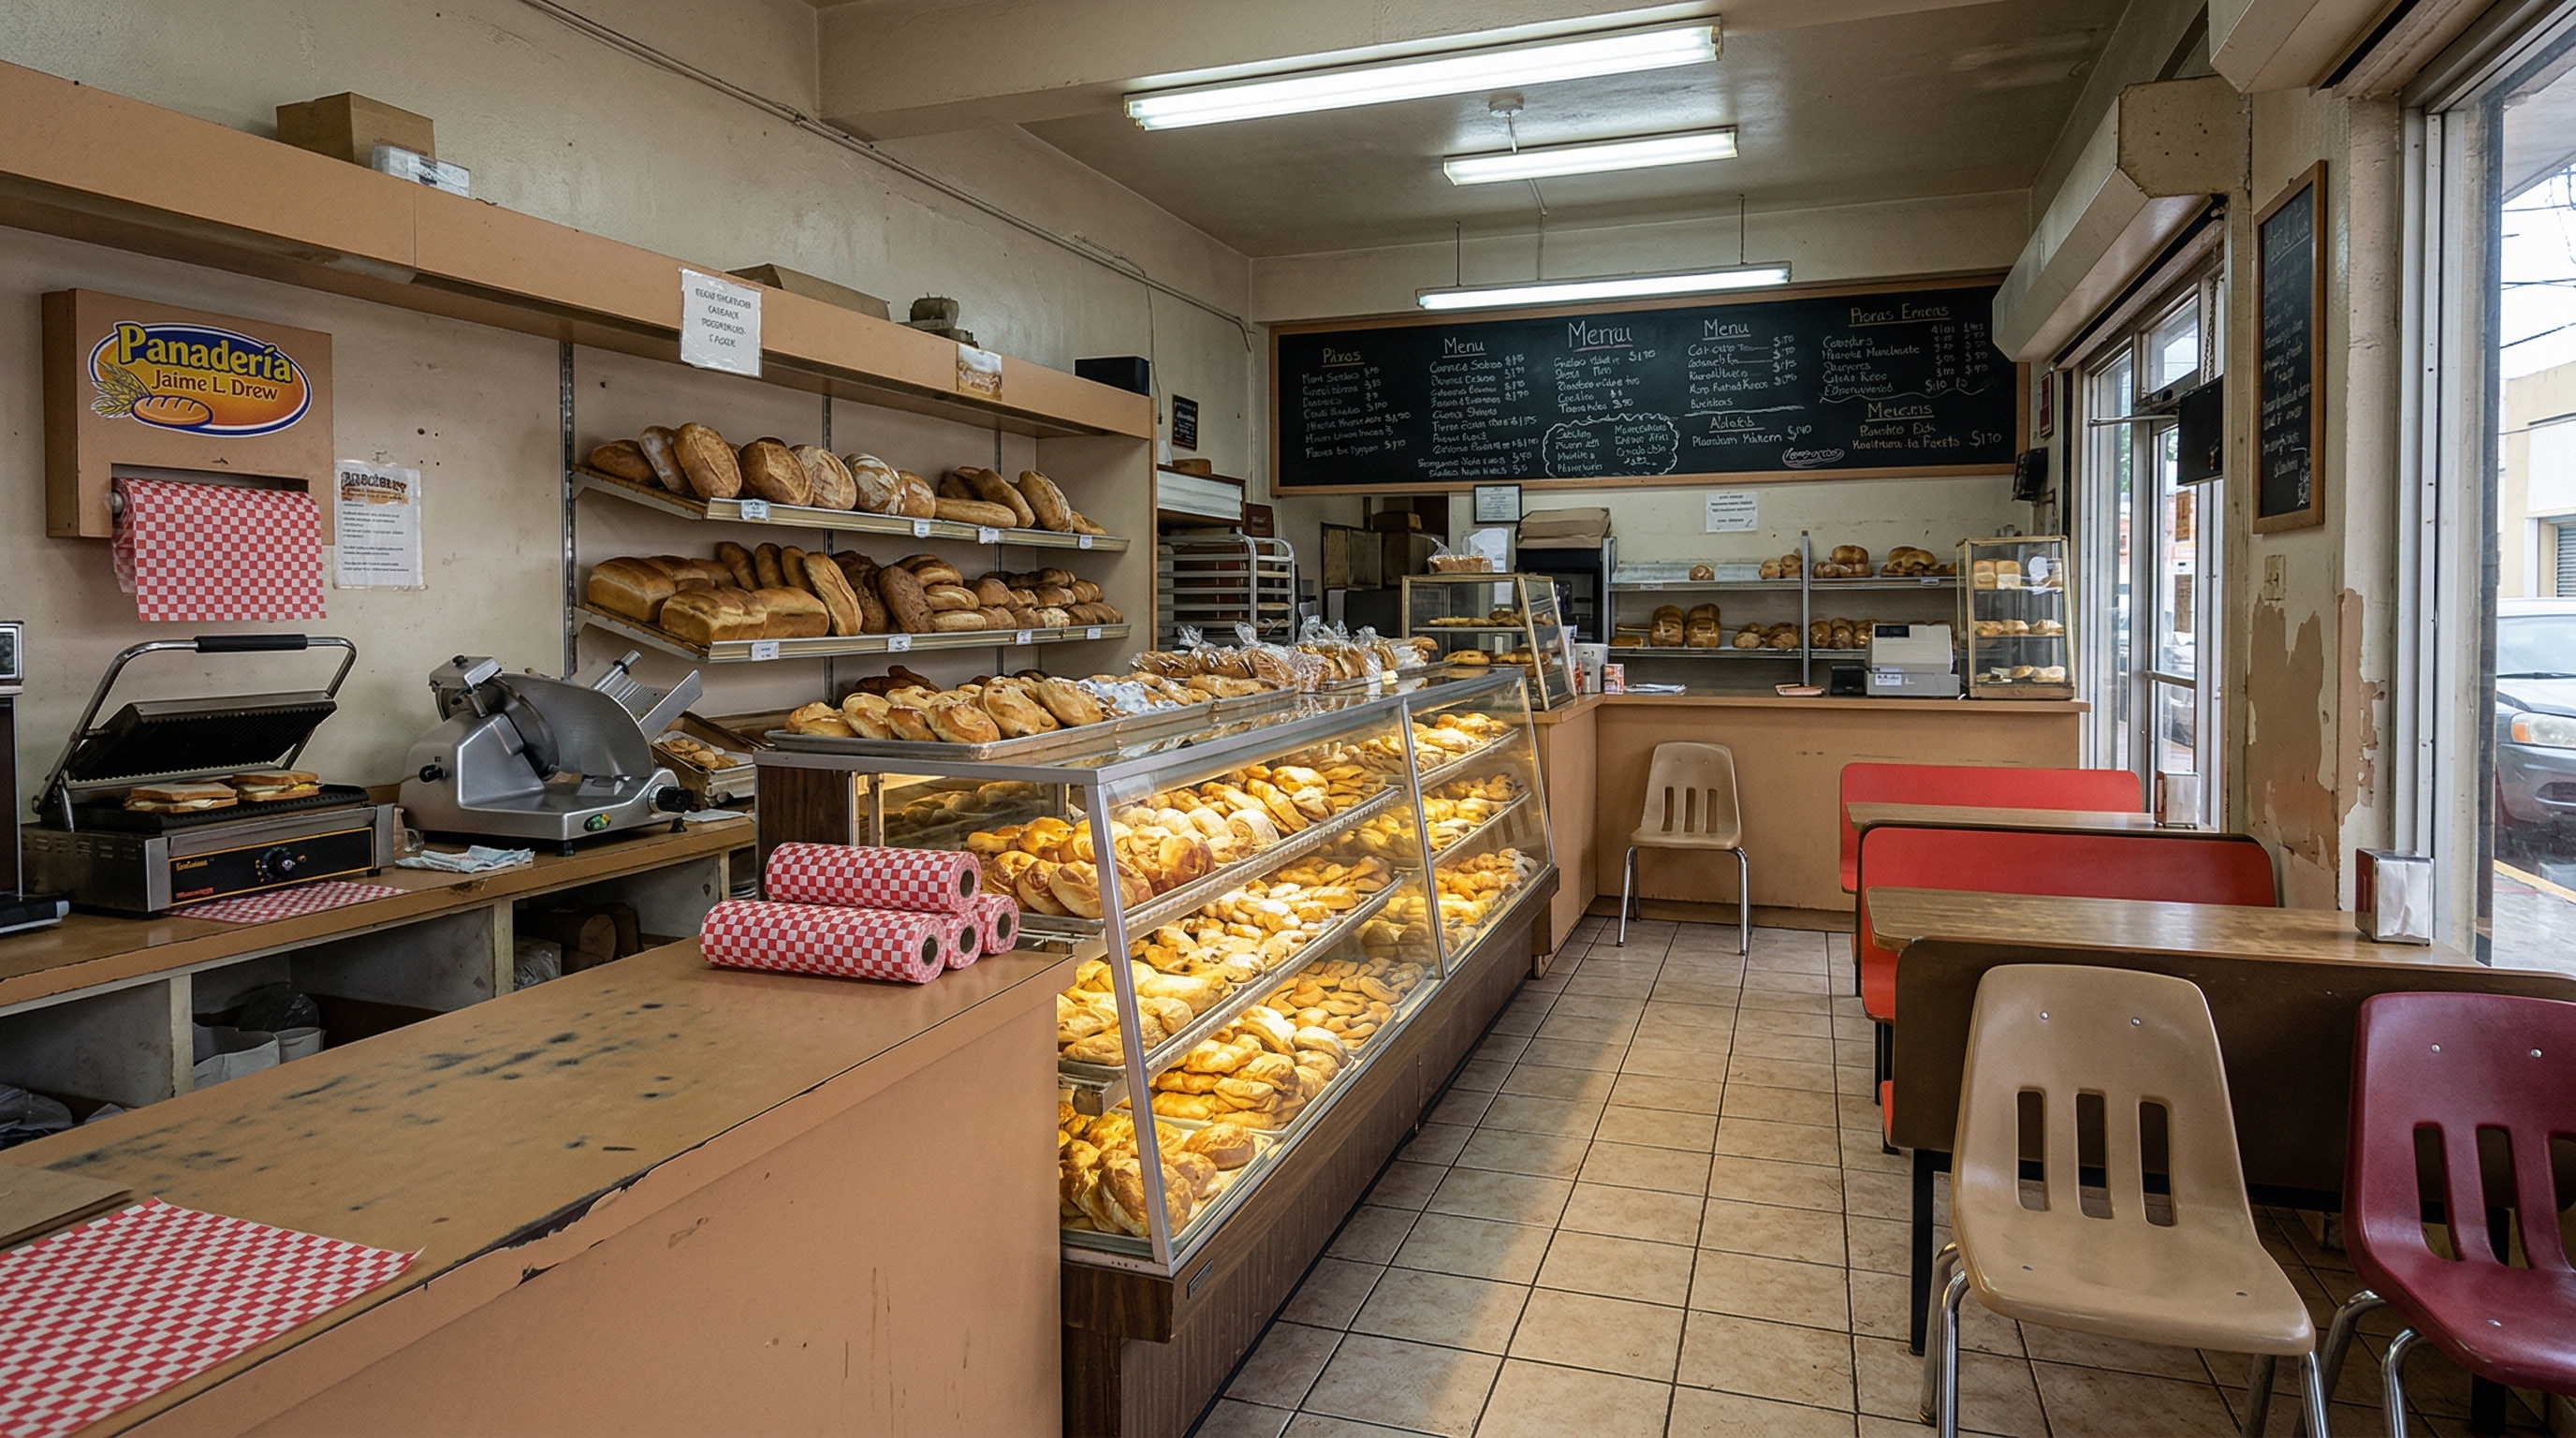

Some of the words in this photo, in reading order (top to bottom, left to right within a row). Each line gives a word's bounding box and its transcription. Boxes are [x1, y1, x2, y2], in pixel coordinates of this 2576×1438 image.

[1704, 318, 1750, 338] Menu
[118, 324, 292, 382] Panadería
[1444, 337, 1485, 354] Menu
[152, 370, 207, 392] Jaime
[231, 379, 278, 400] Drew
